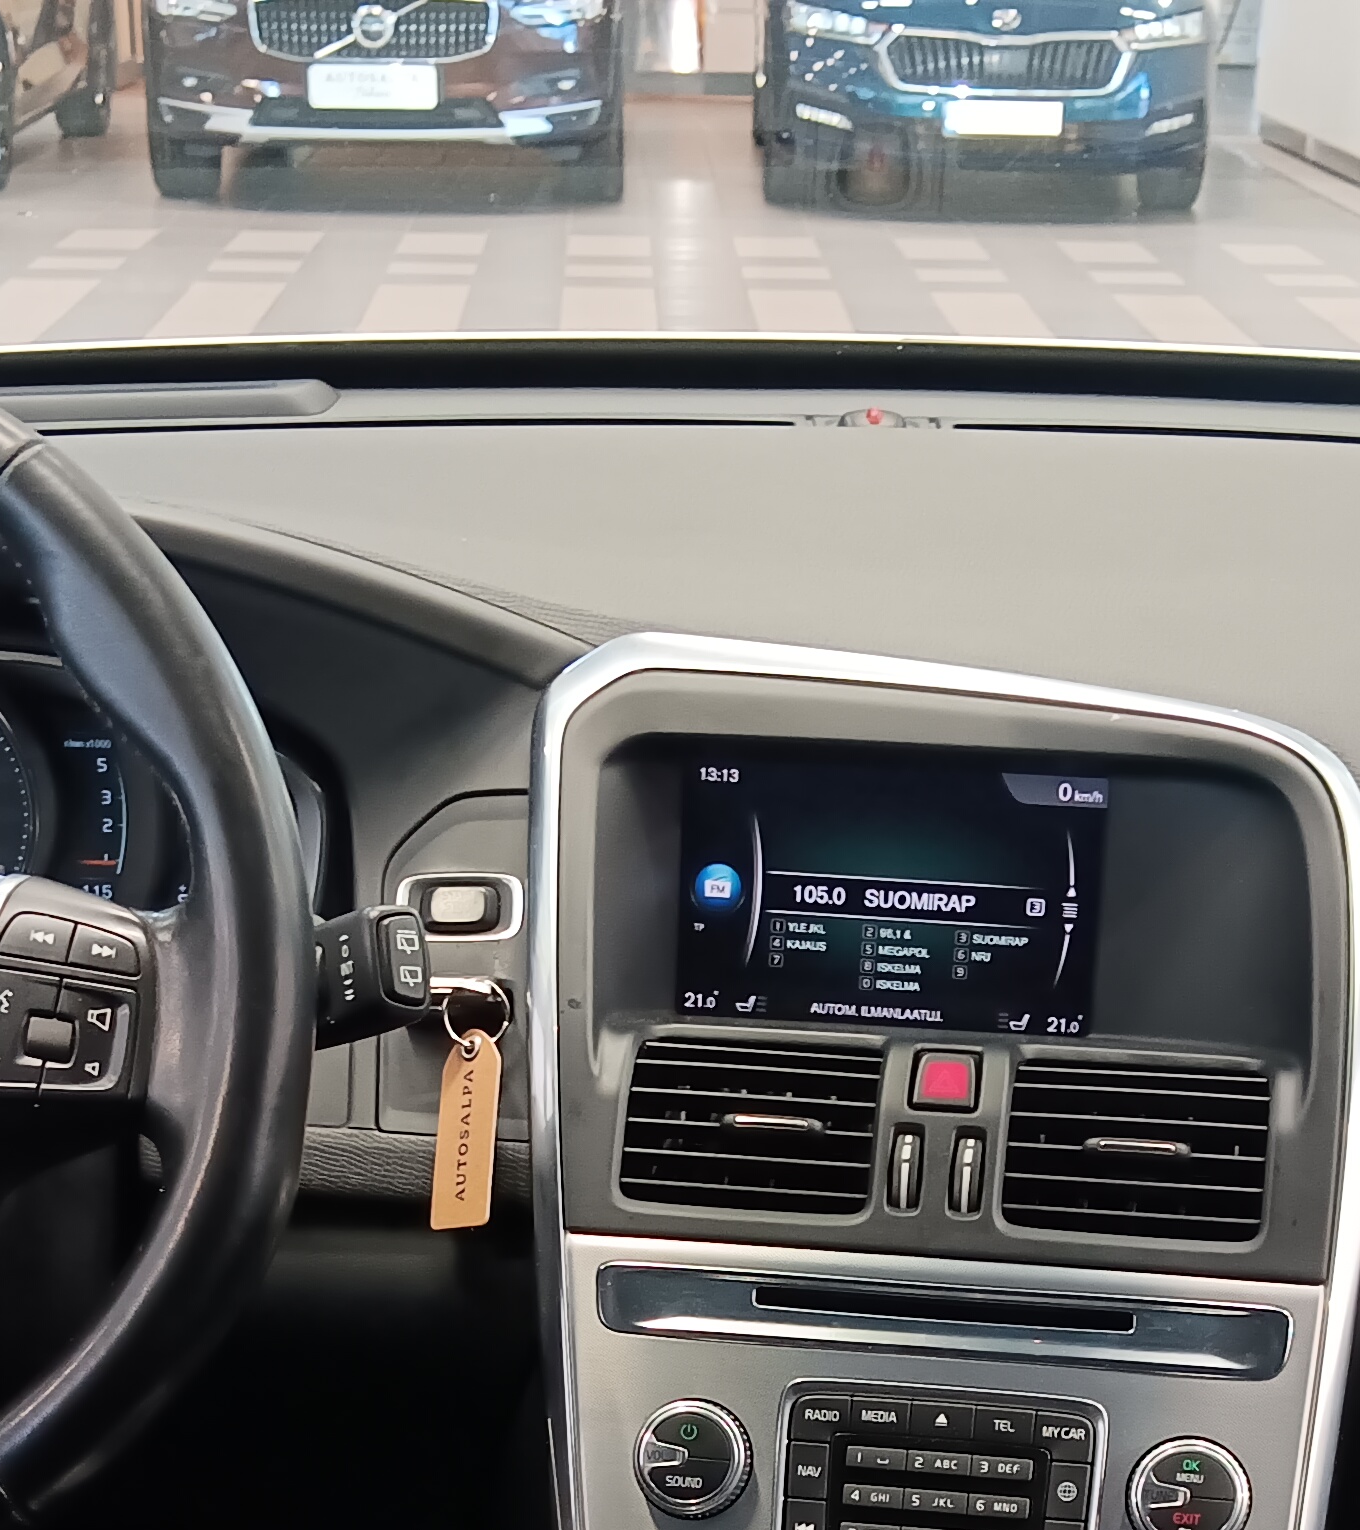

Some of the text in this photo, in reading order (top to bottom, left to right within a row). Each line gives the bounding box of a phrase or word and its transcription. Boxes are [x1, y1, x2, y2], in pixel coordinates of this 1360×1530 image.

[96, 757, 108, 773] 5
[700, 767, 740, 783] 13:13
[101, 790, 112, 805] 3
[1058, 783, 1104, 803] 0 km/h
[102, 818, 113, 833] 2
[710, 884, 727, 895] FM
[793, 885, 846, 906] 105.0
[863, 888, 976, 914] SUOMIRAP
[787, 922, 807, 933] YLE
[972, 934, 1029, 947] SUOMIRAP
[878, 945, 931, 959] MEGAPOL
[810, 1002, 859, 1017] AUTOM.
[454, 1068, 474, 1202] AUTOSALPA
[804, 1408, 840, 1422] RADIO
[861, 1409, 897, 1424] MEDIA
[993, 1419, 1016, 1433] TEL
[1042, 1425, 1086, 1441] MY CAR
[914, 1456, 958, 1471] 2 ABC
[979, 1460, 1021, 1475] 3 DEF
[1182, 1459, 1201, 1472] OK
[797, 1464, 822, 1478] NAV
[1175, 1472, 1205, 1484] MENU
[665, 1475, 703, 1489] SOUND
[850, 1489, 890, 1503] 4 GHI
[911, 1494, 956, 1508] 5 JKL
[975, 1499, 1018, 1513] 6 MNO
[1172, 1512, 1202, 1526] EXIT
